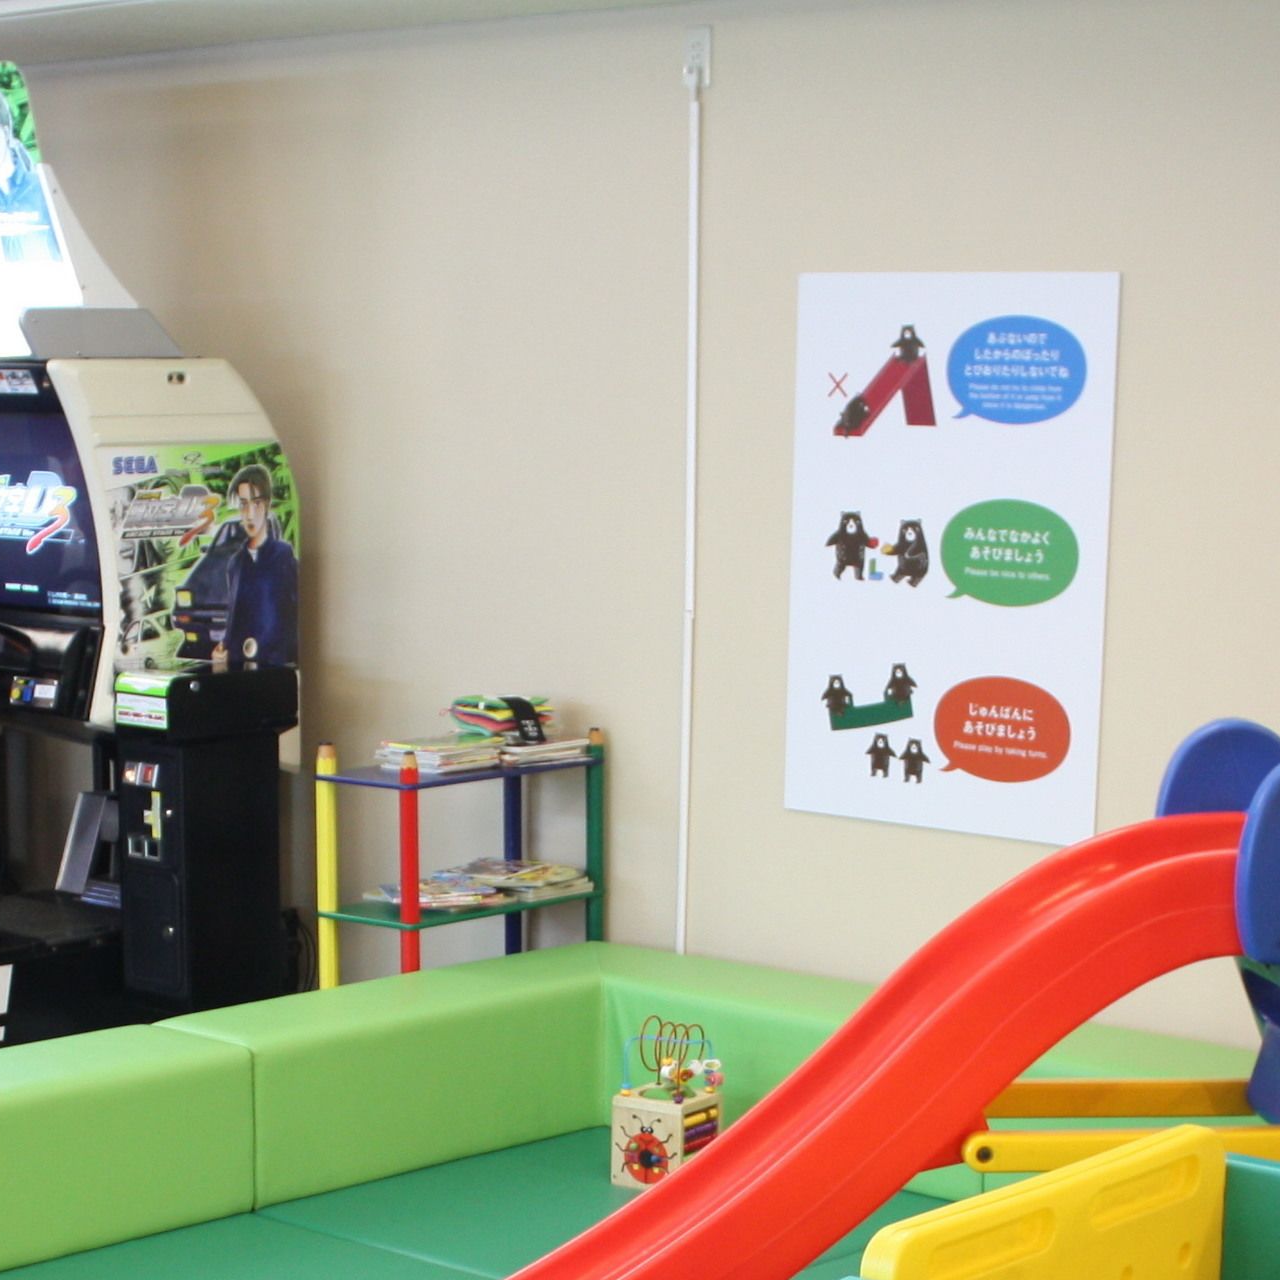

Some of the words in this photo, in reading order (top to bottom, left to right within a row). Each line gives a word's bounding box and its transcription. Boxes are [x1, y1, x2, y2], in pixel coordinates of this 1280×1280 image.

[111, 455, 158, 475] SEGA
[963, 526, 1051, 546] みんなでなかよく
[969, 545, 1045, 565] あそびましょう
[968, 702, 1035, 721] じゅんばんに
[962, 719, 1038, 741] あそびましょう
